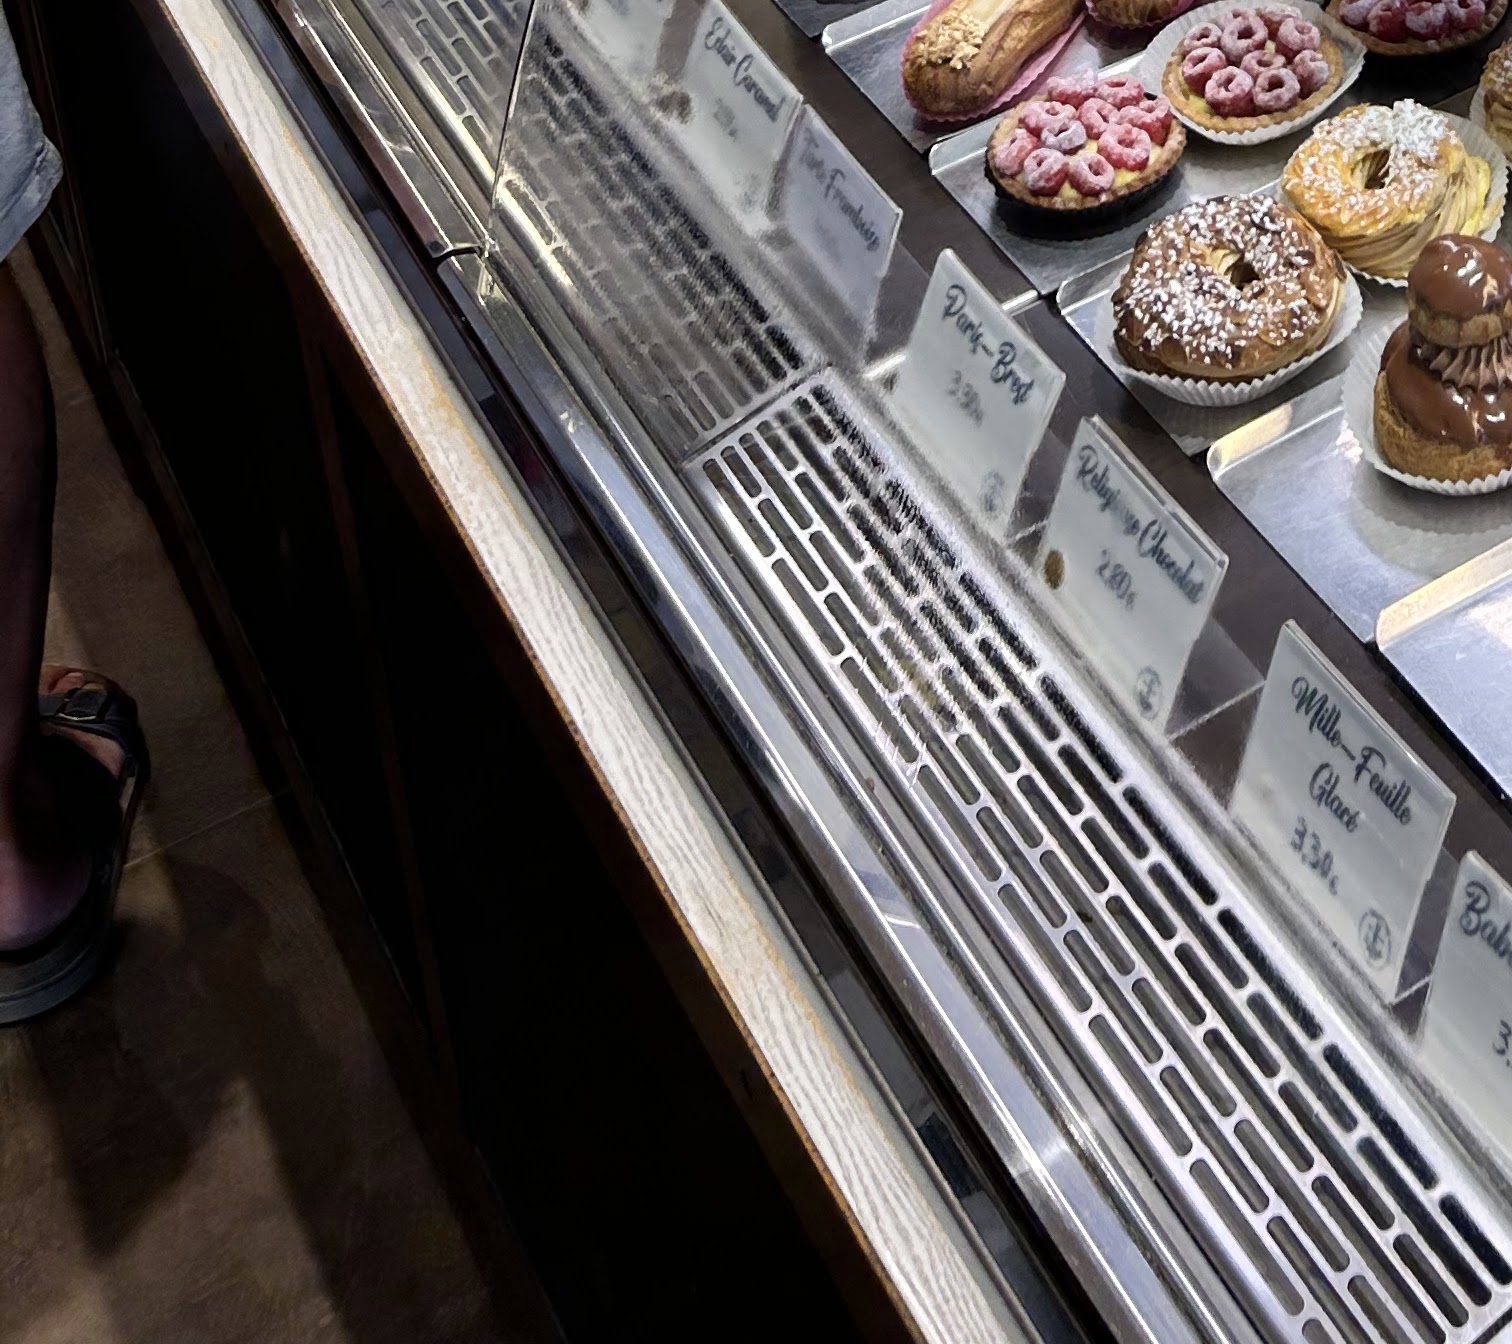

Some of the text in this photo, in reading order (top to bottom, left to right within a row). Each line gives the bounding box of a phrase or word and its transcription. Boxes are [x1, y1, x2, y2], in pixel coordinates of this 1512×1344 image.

[1077, 443, 1206, 606] Religise Chocolat
[1291, 675, 1413, 826] Mille-Feuille
